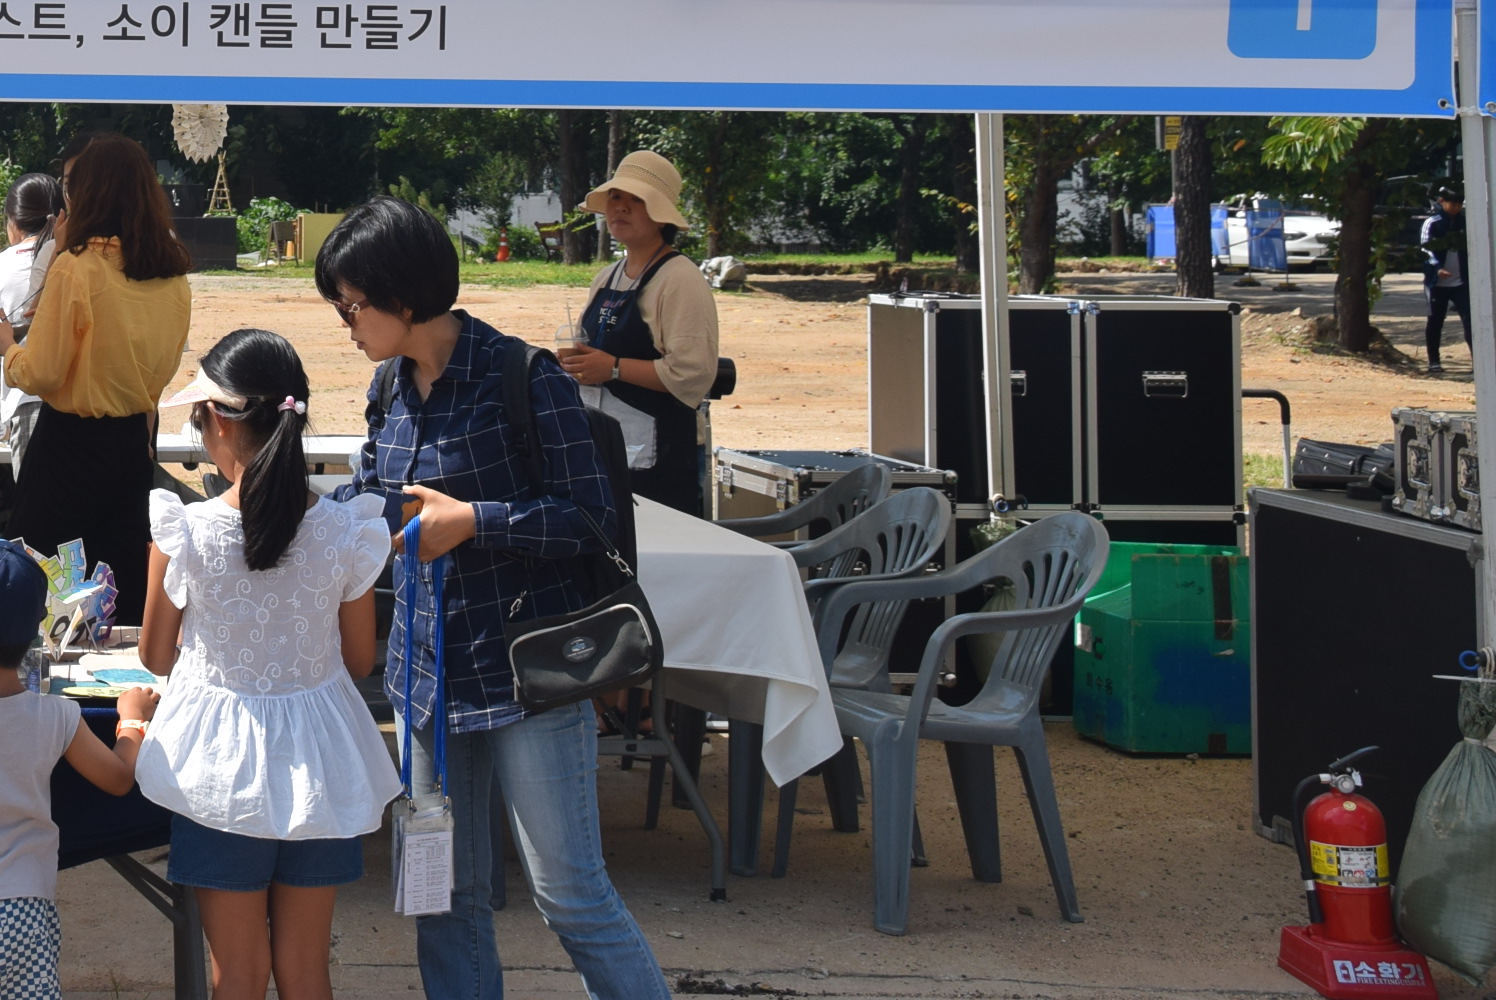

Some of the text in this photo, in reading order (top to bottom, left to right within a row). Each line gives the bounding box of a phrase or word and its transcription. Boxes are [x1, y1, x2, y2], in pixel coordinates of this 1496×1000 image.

[102, 1, 189, 47] 소이
[209, 2, 298, 49] 캔들
[315, 3, 447, 51] 만들기
[1354, 961, 1424, 980] 소화기
[1356, 977, 1373, 985] FIRE
